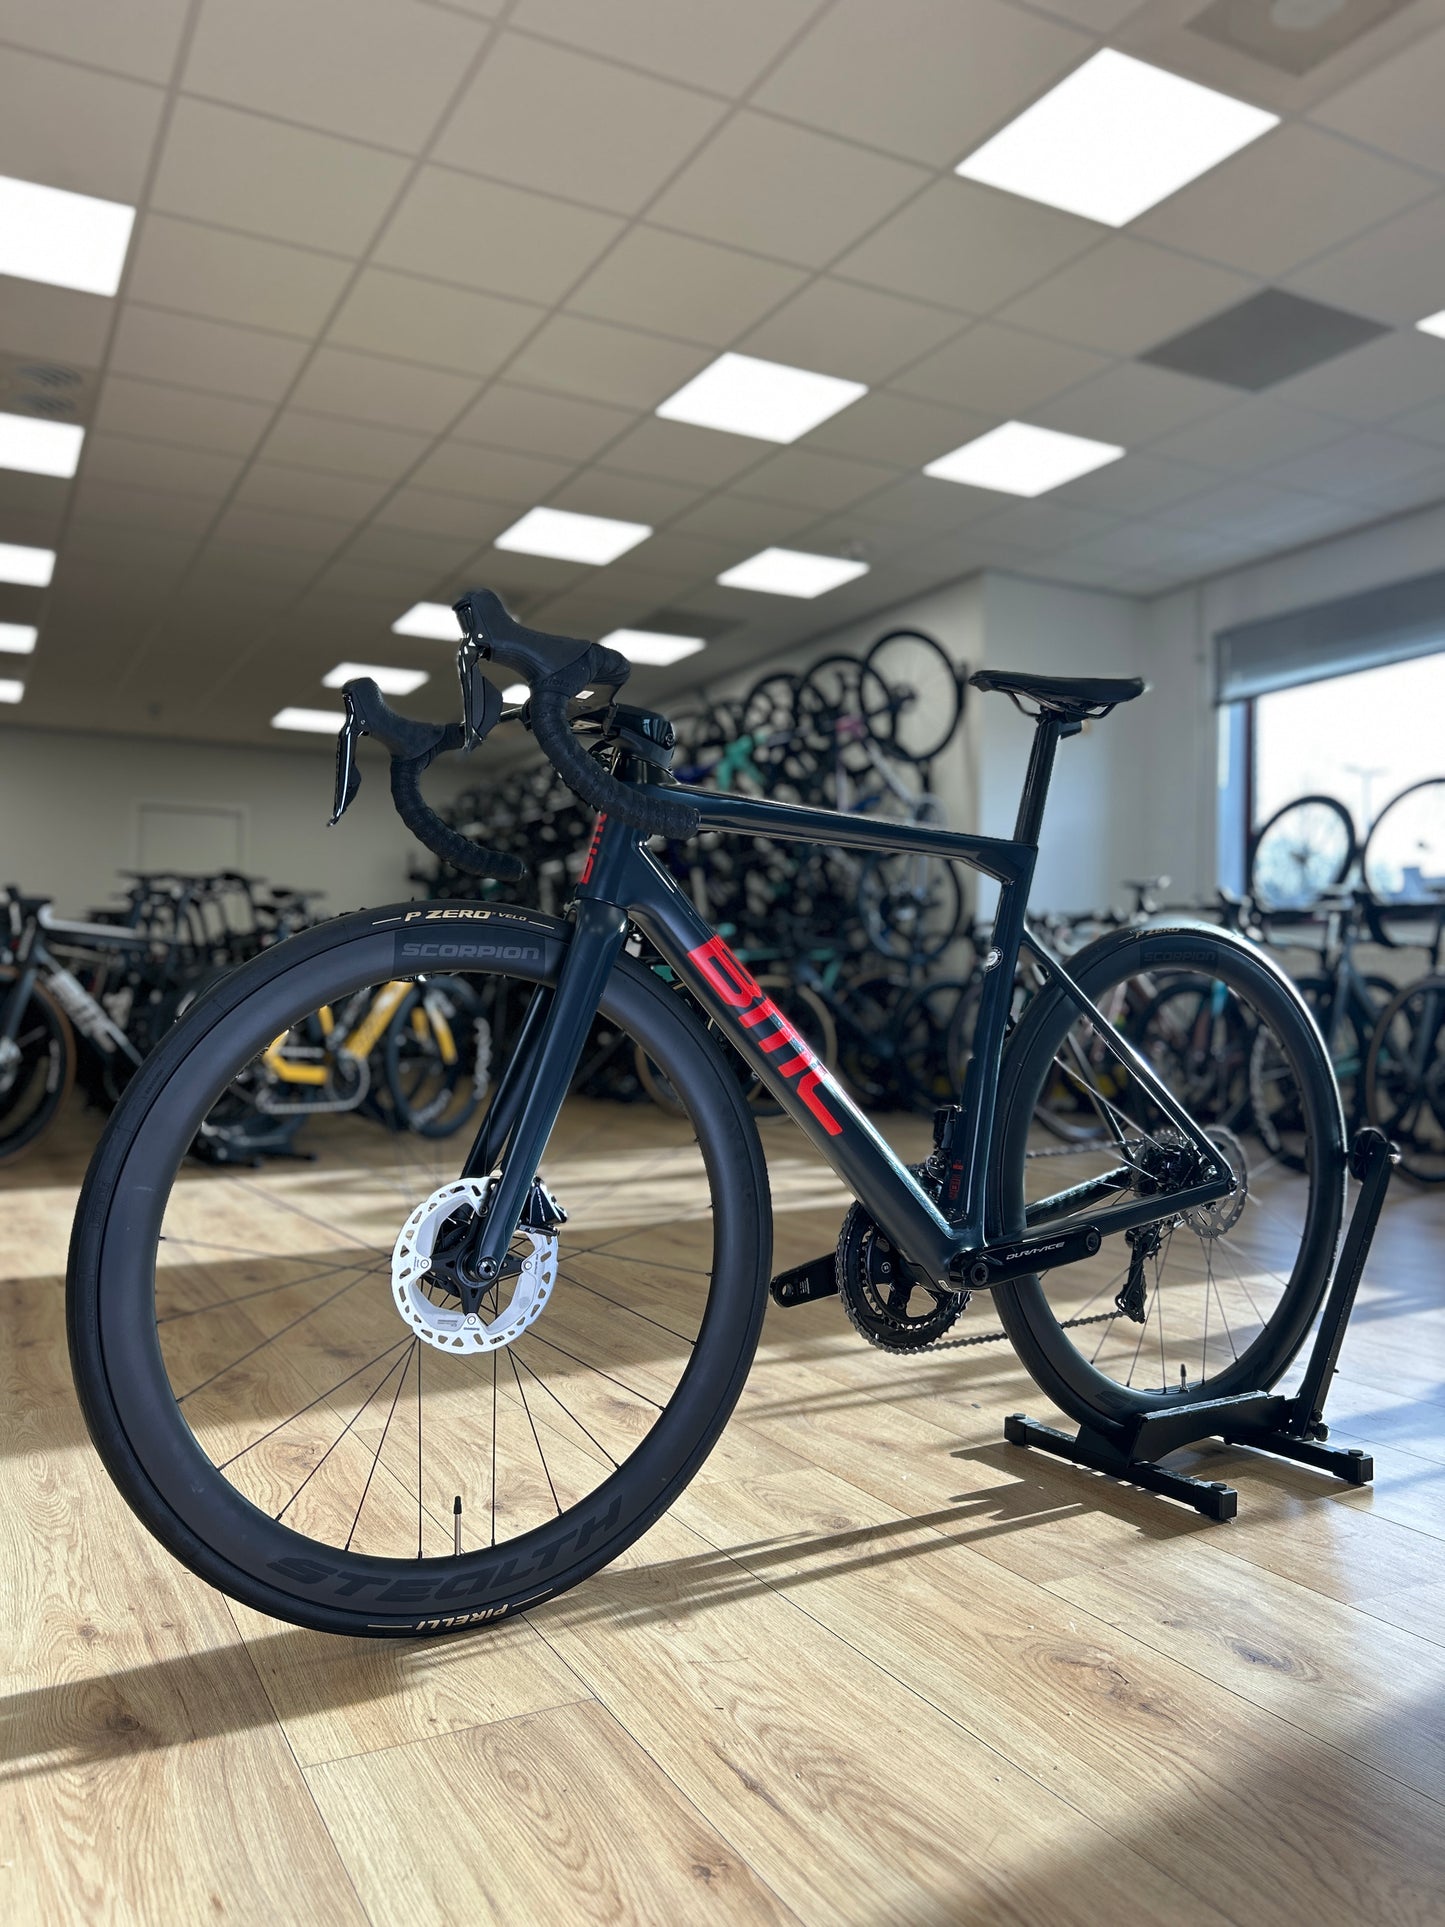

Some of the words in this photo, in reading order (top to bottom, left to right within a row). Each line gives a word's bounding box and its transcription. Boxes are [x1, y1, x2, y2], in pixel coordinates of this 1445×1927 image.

[404, 911, 422, 922] P
[498, 911, 528, 922] VELO
[401, 942, 540, 961] SCORPION
[1006, 1241, 1066, 1261] DURA-ACE
[265, 1493, 623, 1601] STEALTH
[415, 1602, 510, 1632] PIRELLI
